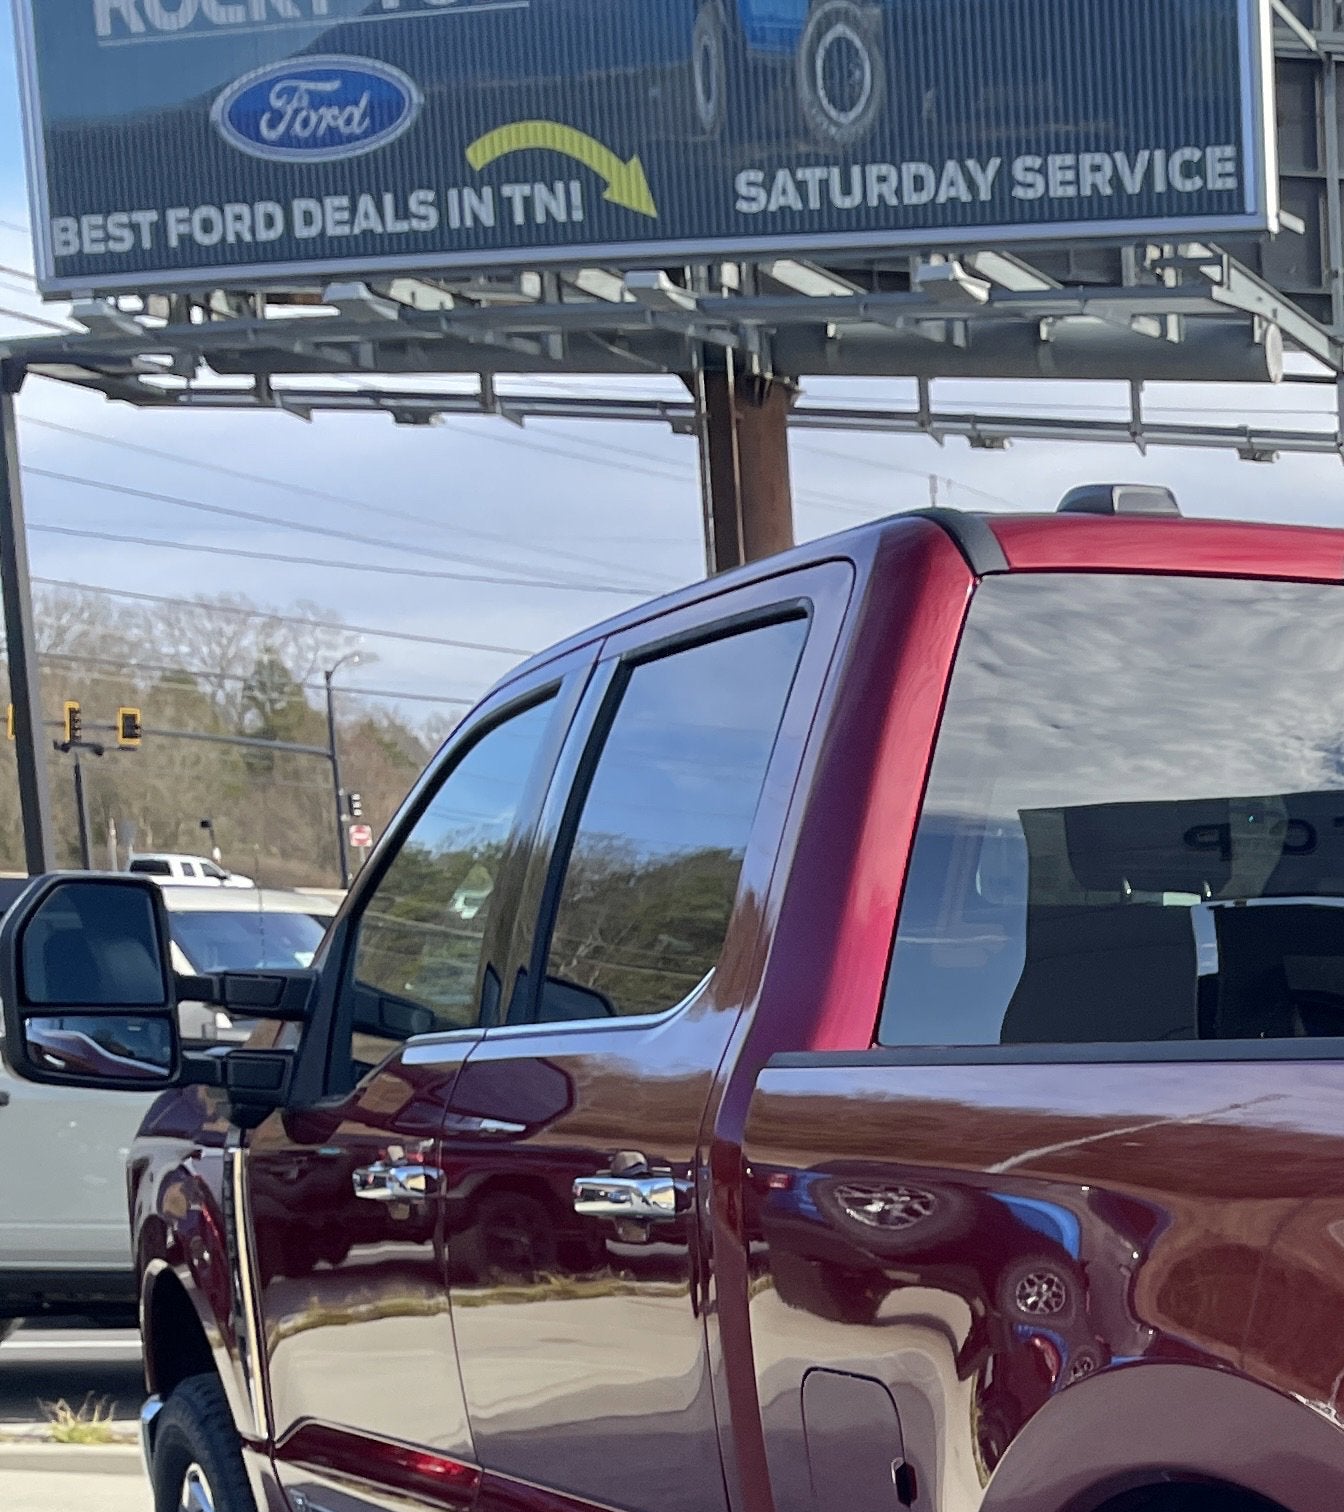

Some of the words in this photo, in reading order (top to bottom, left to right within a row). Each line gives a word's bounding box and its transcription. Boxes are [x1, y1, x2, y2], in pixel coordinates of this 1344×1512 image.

[260, 79, 370, 140] Ford
[734, 157, 1002, 213] SATURDAY
[1011, 145, 1239, 200] SERVICE
[52, 209, 158, 257] BEST
[166, 201, 286, 248] FORD
[292, 188, 439, 239] DEALS
[447, 185, 496, 229] IN
[500, 179, 585, 224] TN!
